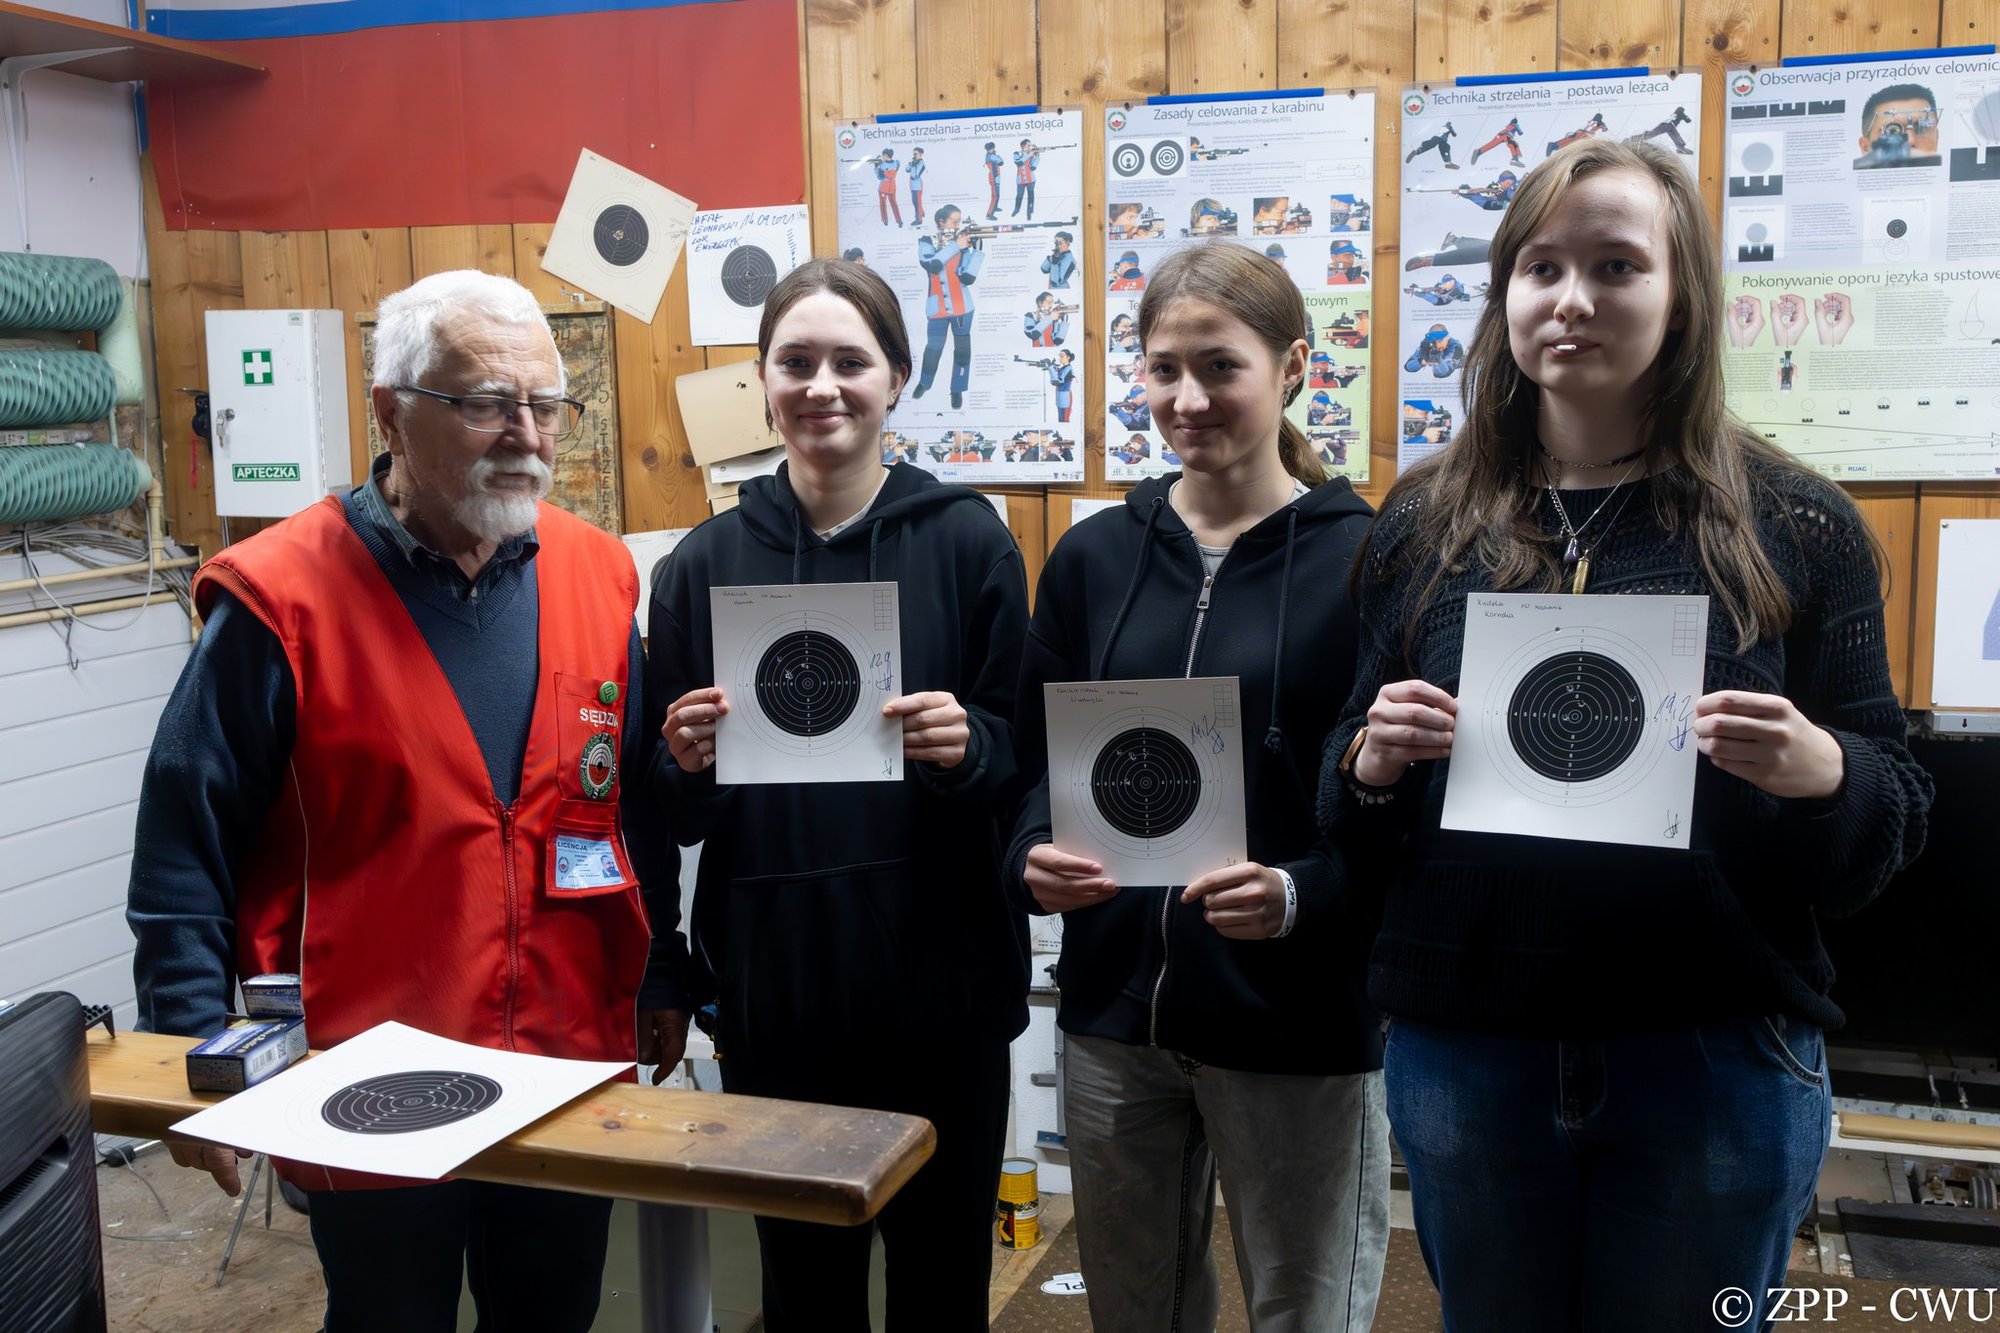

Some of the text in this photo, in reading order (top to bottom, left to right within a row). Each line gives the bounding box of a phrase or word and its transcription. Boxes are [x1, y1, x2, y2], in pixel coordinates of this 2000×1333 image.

[1760, 71, 1841, 86] Obserwacja
[1846, 63, 1930, 82] przyrządów
[1432, 92, 1486, 106] Technika
[1490, 87, 1551, 102] strzelania
[1567, 84, 1624, 99] postawa
[1628, 80, 1670, 96] leżąca
[1154, 100, 1325, 121] Zasady celowania z karabinu
[862, 126, 906, 140] Technika
[910, 122, 961, 138] strzelania
[974, 118, 1022, 135] postawa
[1024, 117, 1064, 133] stojąca
[1742, 273, 1834, 288] Pokonywanie
[1838, 274, 1881, 286] oporu
[1886, 270, 1928, 286] języka
[236, 467, 296, 478] APTECZKA
[558, 841, 588, 851] LICENCJA
